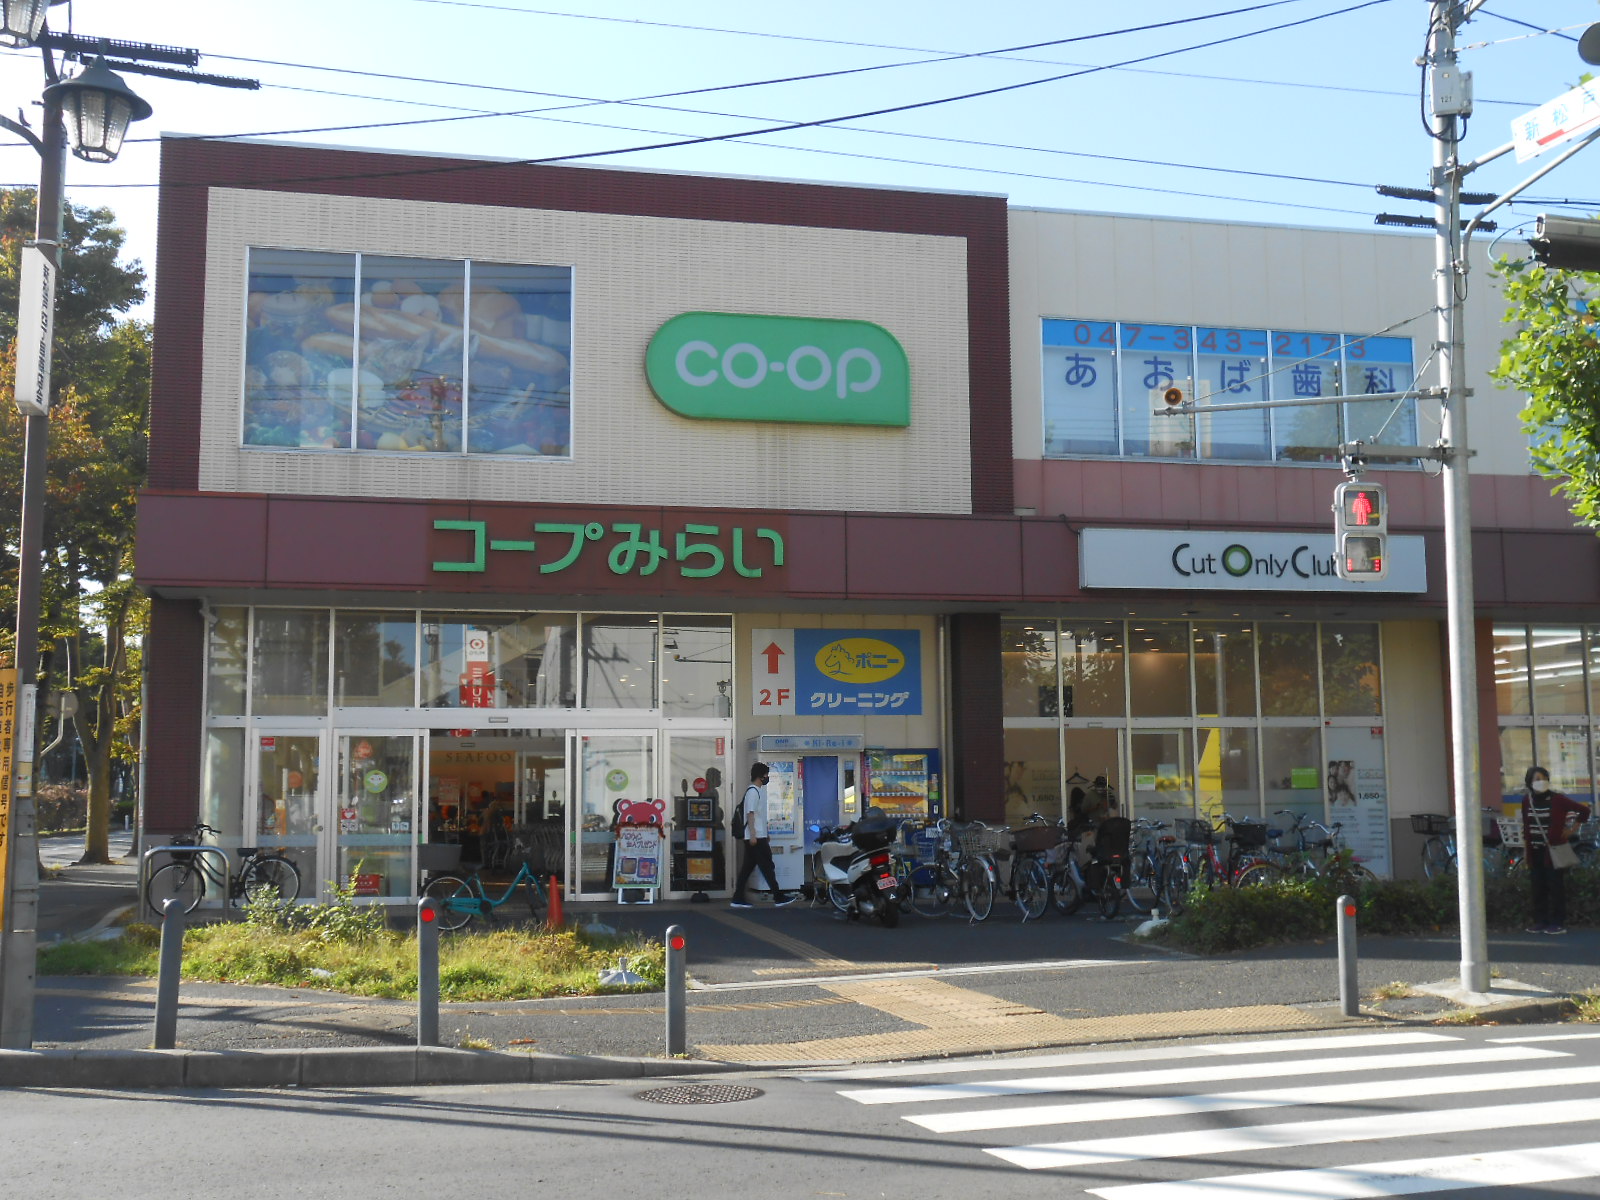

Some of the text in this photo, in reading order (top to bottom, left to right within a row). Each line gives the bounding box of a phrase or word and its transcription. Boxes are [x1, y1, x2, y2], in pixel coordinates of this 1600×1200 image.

[1074, 323, 1367, 359] 047-343-2173
[1064, 352, 1397, 399] あおば歯科
[432, 519, 784, 578] コープみらい
[1172, 543, 1217, 577] Cut
[1221, 543, 1289, 579] Only
[855, 652, 900, 669] ポニー
[810, 691, 910, 708] クリーニング
